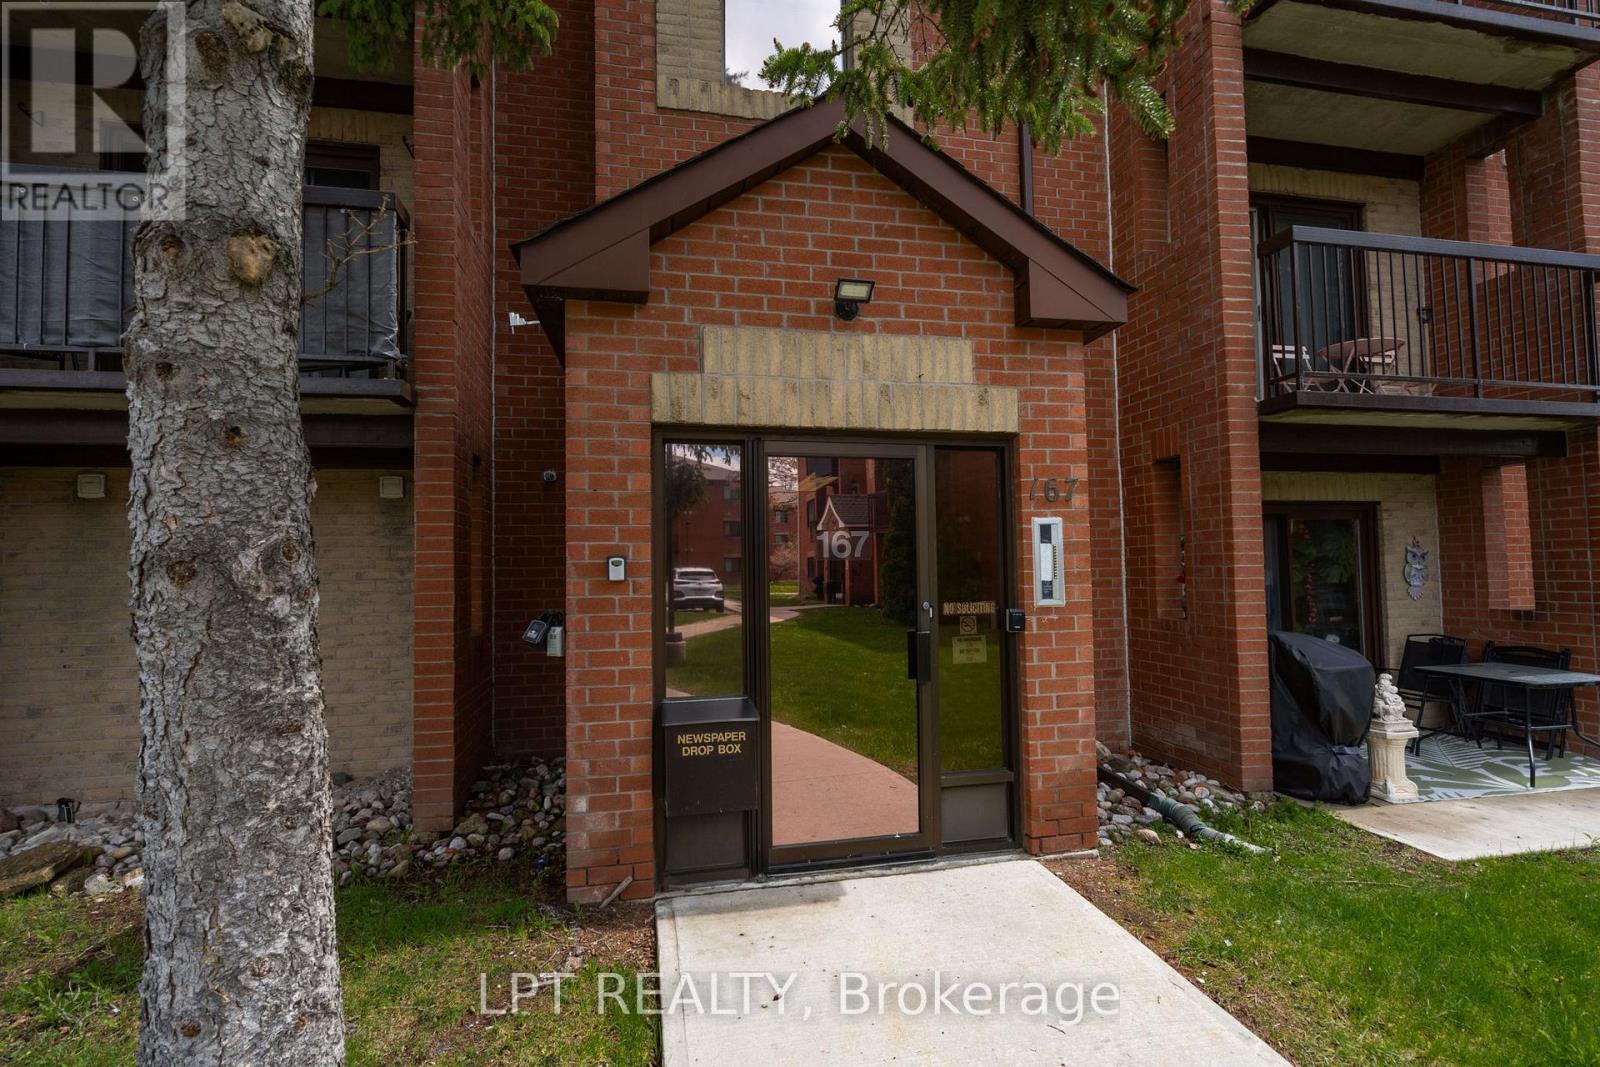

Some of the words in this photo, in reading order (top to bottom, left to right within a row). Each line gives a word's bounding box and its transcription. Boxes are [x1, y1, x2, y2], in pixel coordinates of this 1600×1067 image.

[1029, 477, 1079, 502] 167
[816, 530, 870, 559] 167
[943, 602, 955, 616] NO
[956, 600, 997, 614] SOLICITING
[677, 731, 746, 745] NEWSPAPER
[682, 745, 714, 756] DROP
[718, 743, 742, 754] BOX
